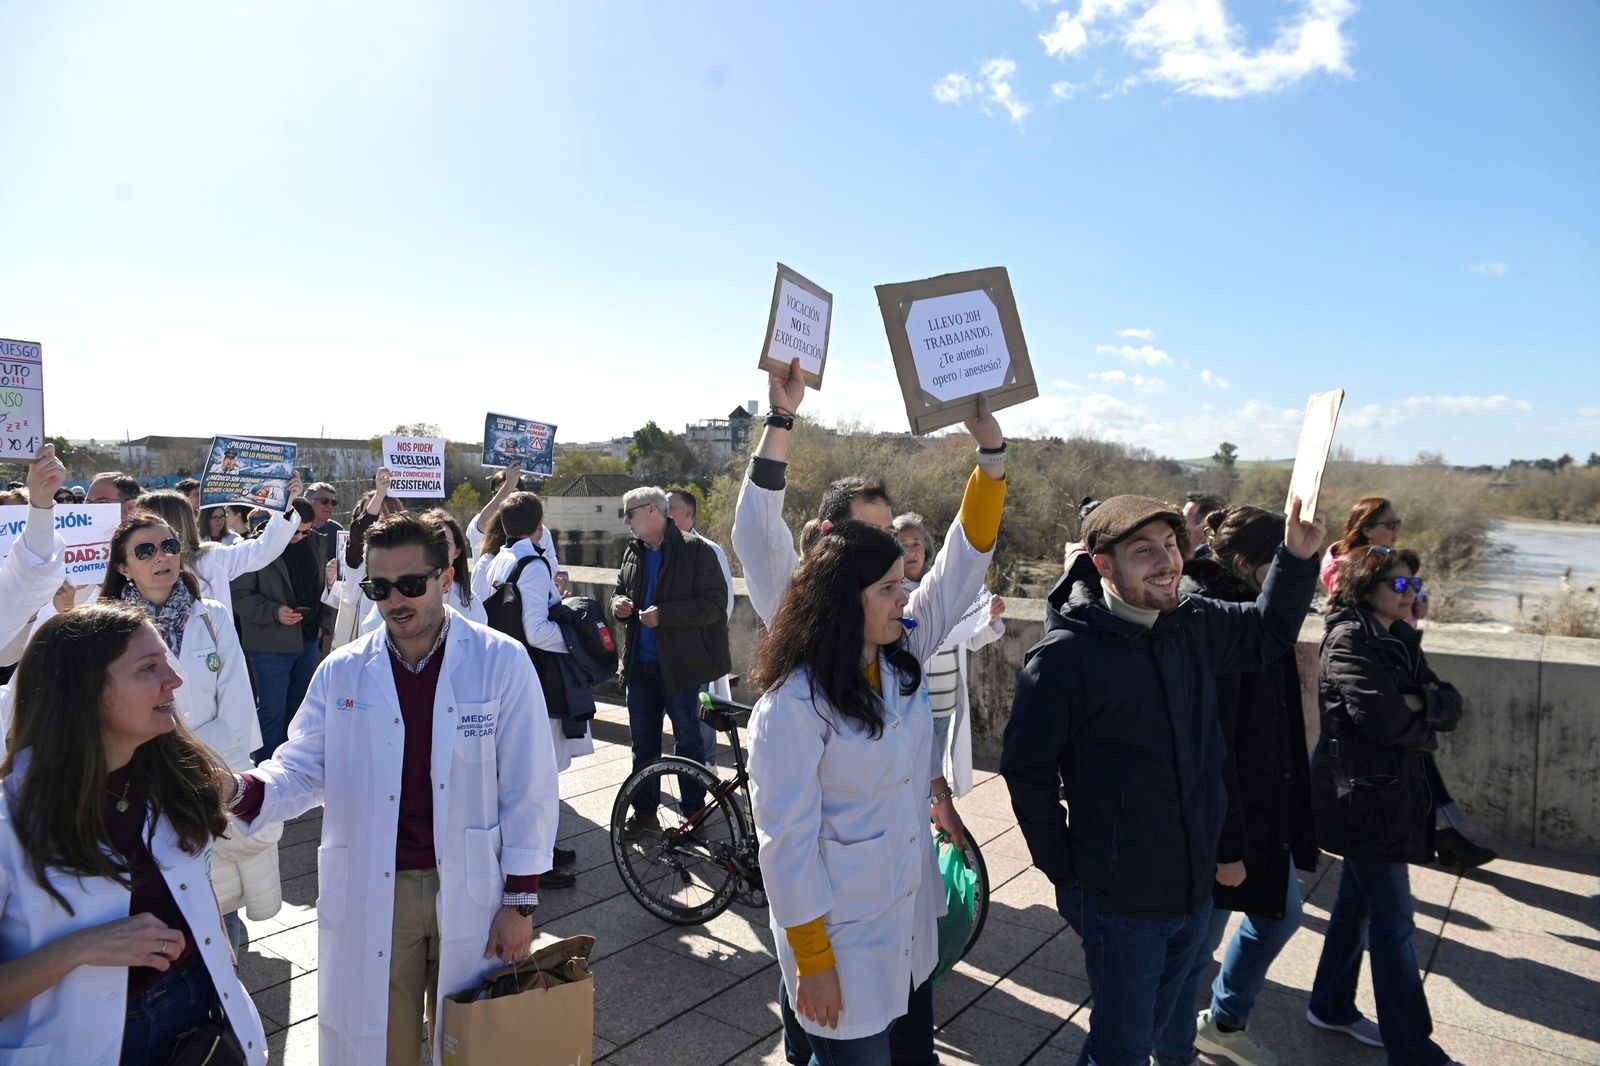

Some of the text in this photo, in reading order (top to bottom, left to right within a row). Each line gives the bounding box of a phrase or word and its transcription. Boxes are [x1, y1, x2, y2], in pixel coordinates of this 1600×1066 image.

[786, 294, 820, 322] VOCACIÓN
[790, 317, 810, 336] NO ES
[928, 310, 982, 332] LLEVO 20H
[774, 330, 822, 360] EXPLOTACIÓN
[923, 326, 993, 350] TRABAJANDO,
[940, 352, 954, 368] ¿Te
[956, 345, 985, 362] atiendo
[932, 372, 958, 388] opero
[964, 358, 1002, 378] anestesio?
[496, 418, 517, 426] GUARDIA
[227, 441, 250, 450] ¿PILOTO
[260, 444, 284, 454] DORMIR?
[398, 442, 433, 452] NOS PIDEN
[390, 454, 441, 466] EXCELENCIA
[390, 480, 441, 490] RESISTENCIA
[462, 714, 492, 723] MEDIC
